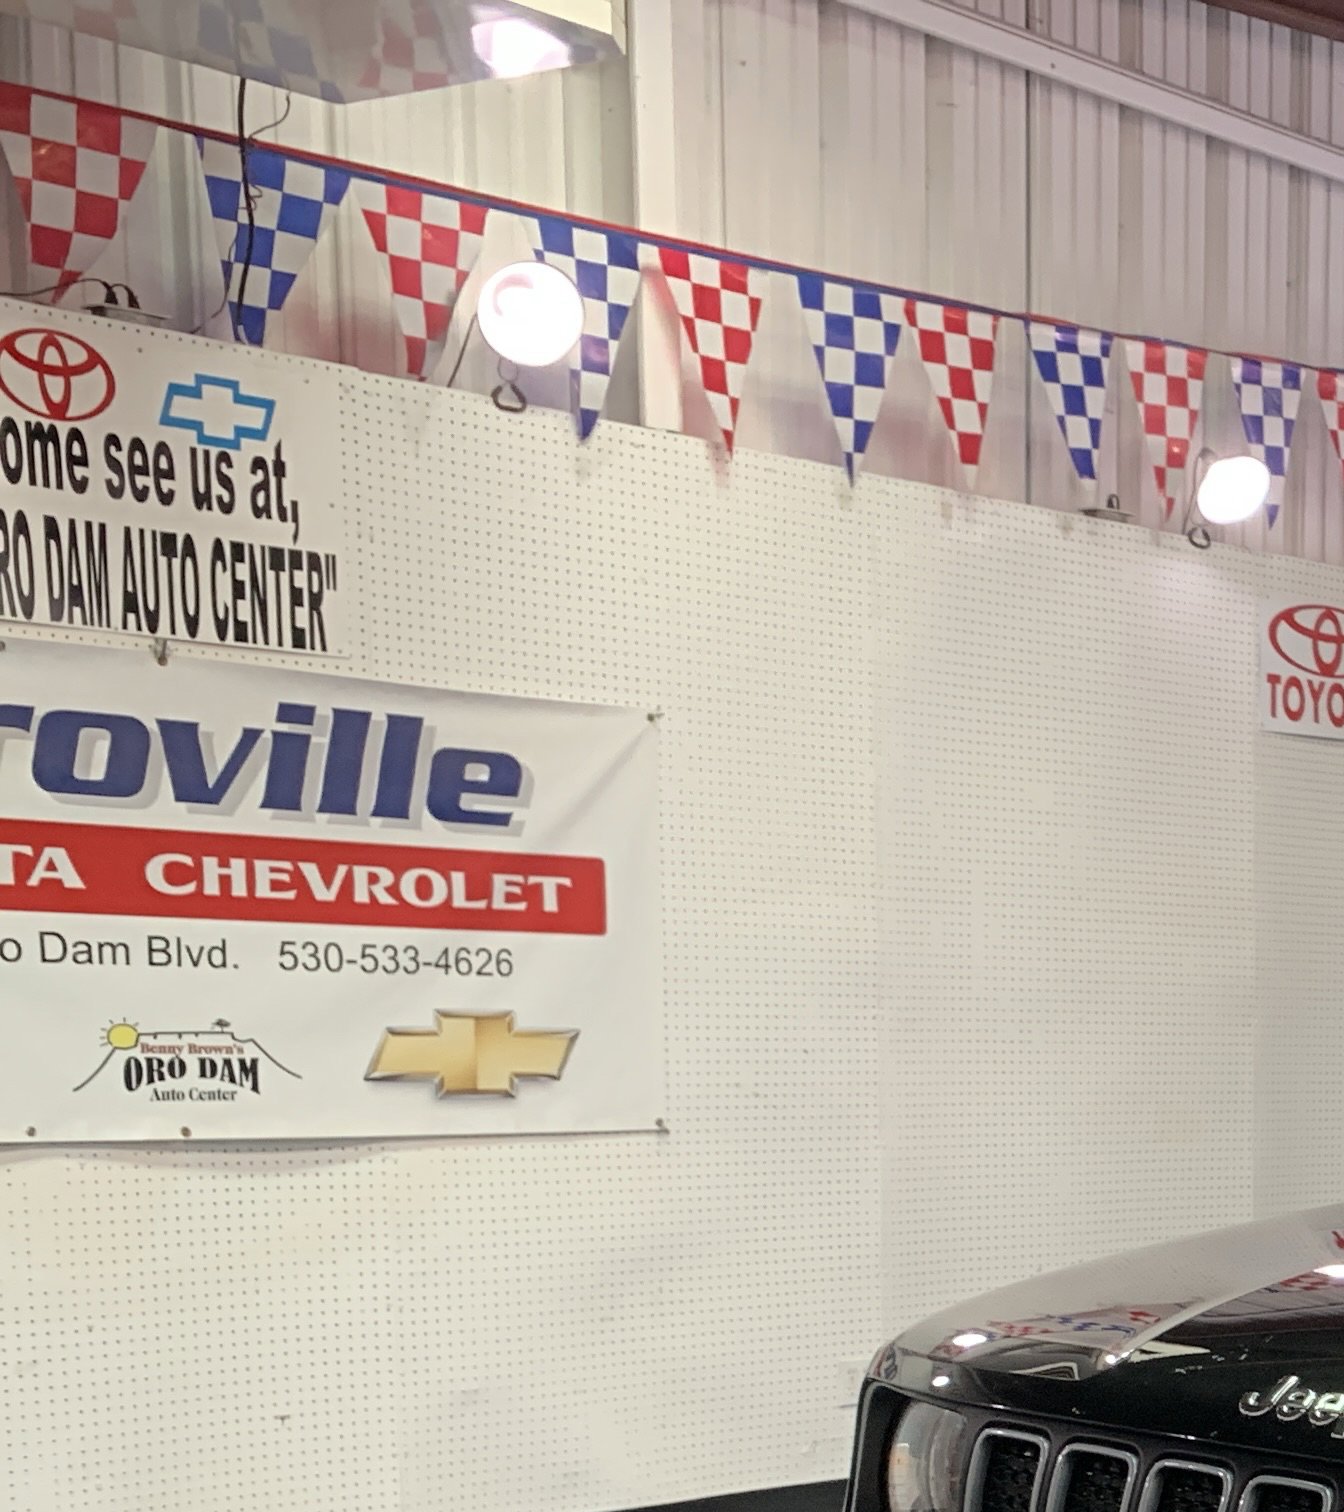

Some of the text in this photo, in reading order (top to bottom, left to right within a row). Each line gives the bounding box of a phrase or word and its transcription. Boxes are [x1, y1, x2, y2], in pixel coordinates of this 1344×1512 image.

[104, 433, 176, 506] see
[190, 446, 235, 515] us
[250, 438, 299, 546] at,
[43, 514, 111, 629] DAM
[122, 526, 200, 640] AUTO
[210, 537, 337, 652] CENTER"
[145, 852, 573, 914] CHEVROLET
[39, 931, 130, 966] Dam
[147, 935, 239, 970] Blvd.
[278, 940, 514, 977] 530-533-4626
[140, 1042, 244, 1056] Benny Brown's
[123, 1056, 260, 1094] ORO DAM
[150, 1087, 237, 1102] Auto Center
